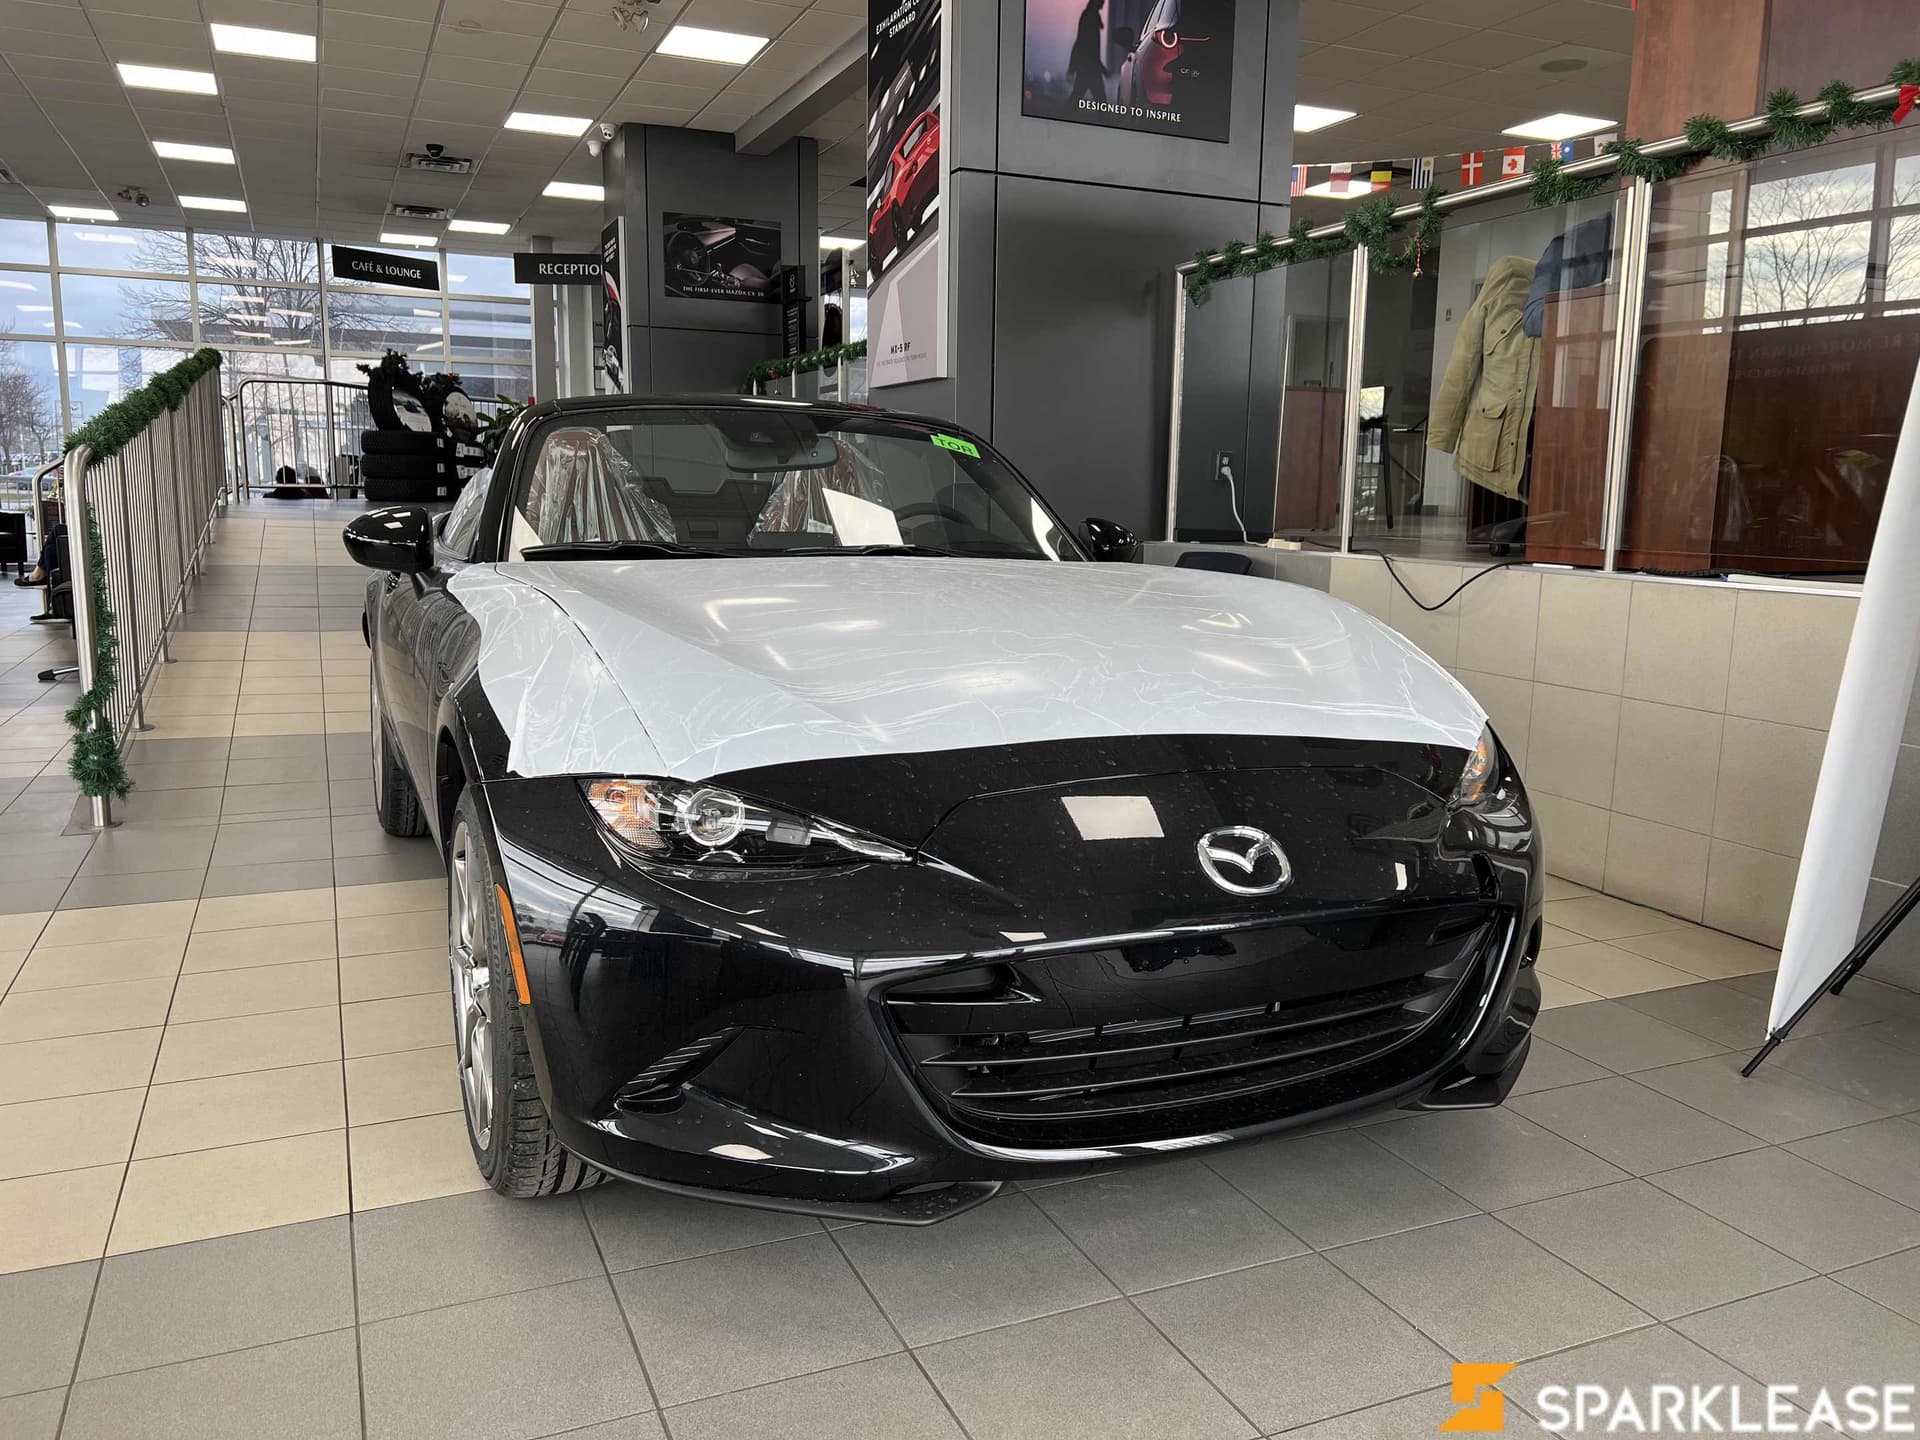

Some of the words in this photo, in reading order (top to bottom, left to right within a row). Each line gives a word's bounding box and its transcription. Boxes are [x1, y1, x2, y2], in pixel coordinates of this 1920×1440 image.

[889, 10, 916, 38] STANDARD
[1078, 99, 1127, 115] DESIGNED
[1130, 107, 1143, 117] TO
[1146, 109, 1182, 122] INSPIRE
[351, 260, 374, 273] CAFÉ
[376, 264, 383, 274] &
[385, 266, 422, 280] LOUNGE
[538, 263, 603, 276] RECEPTIO
